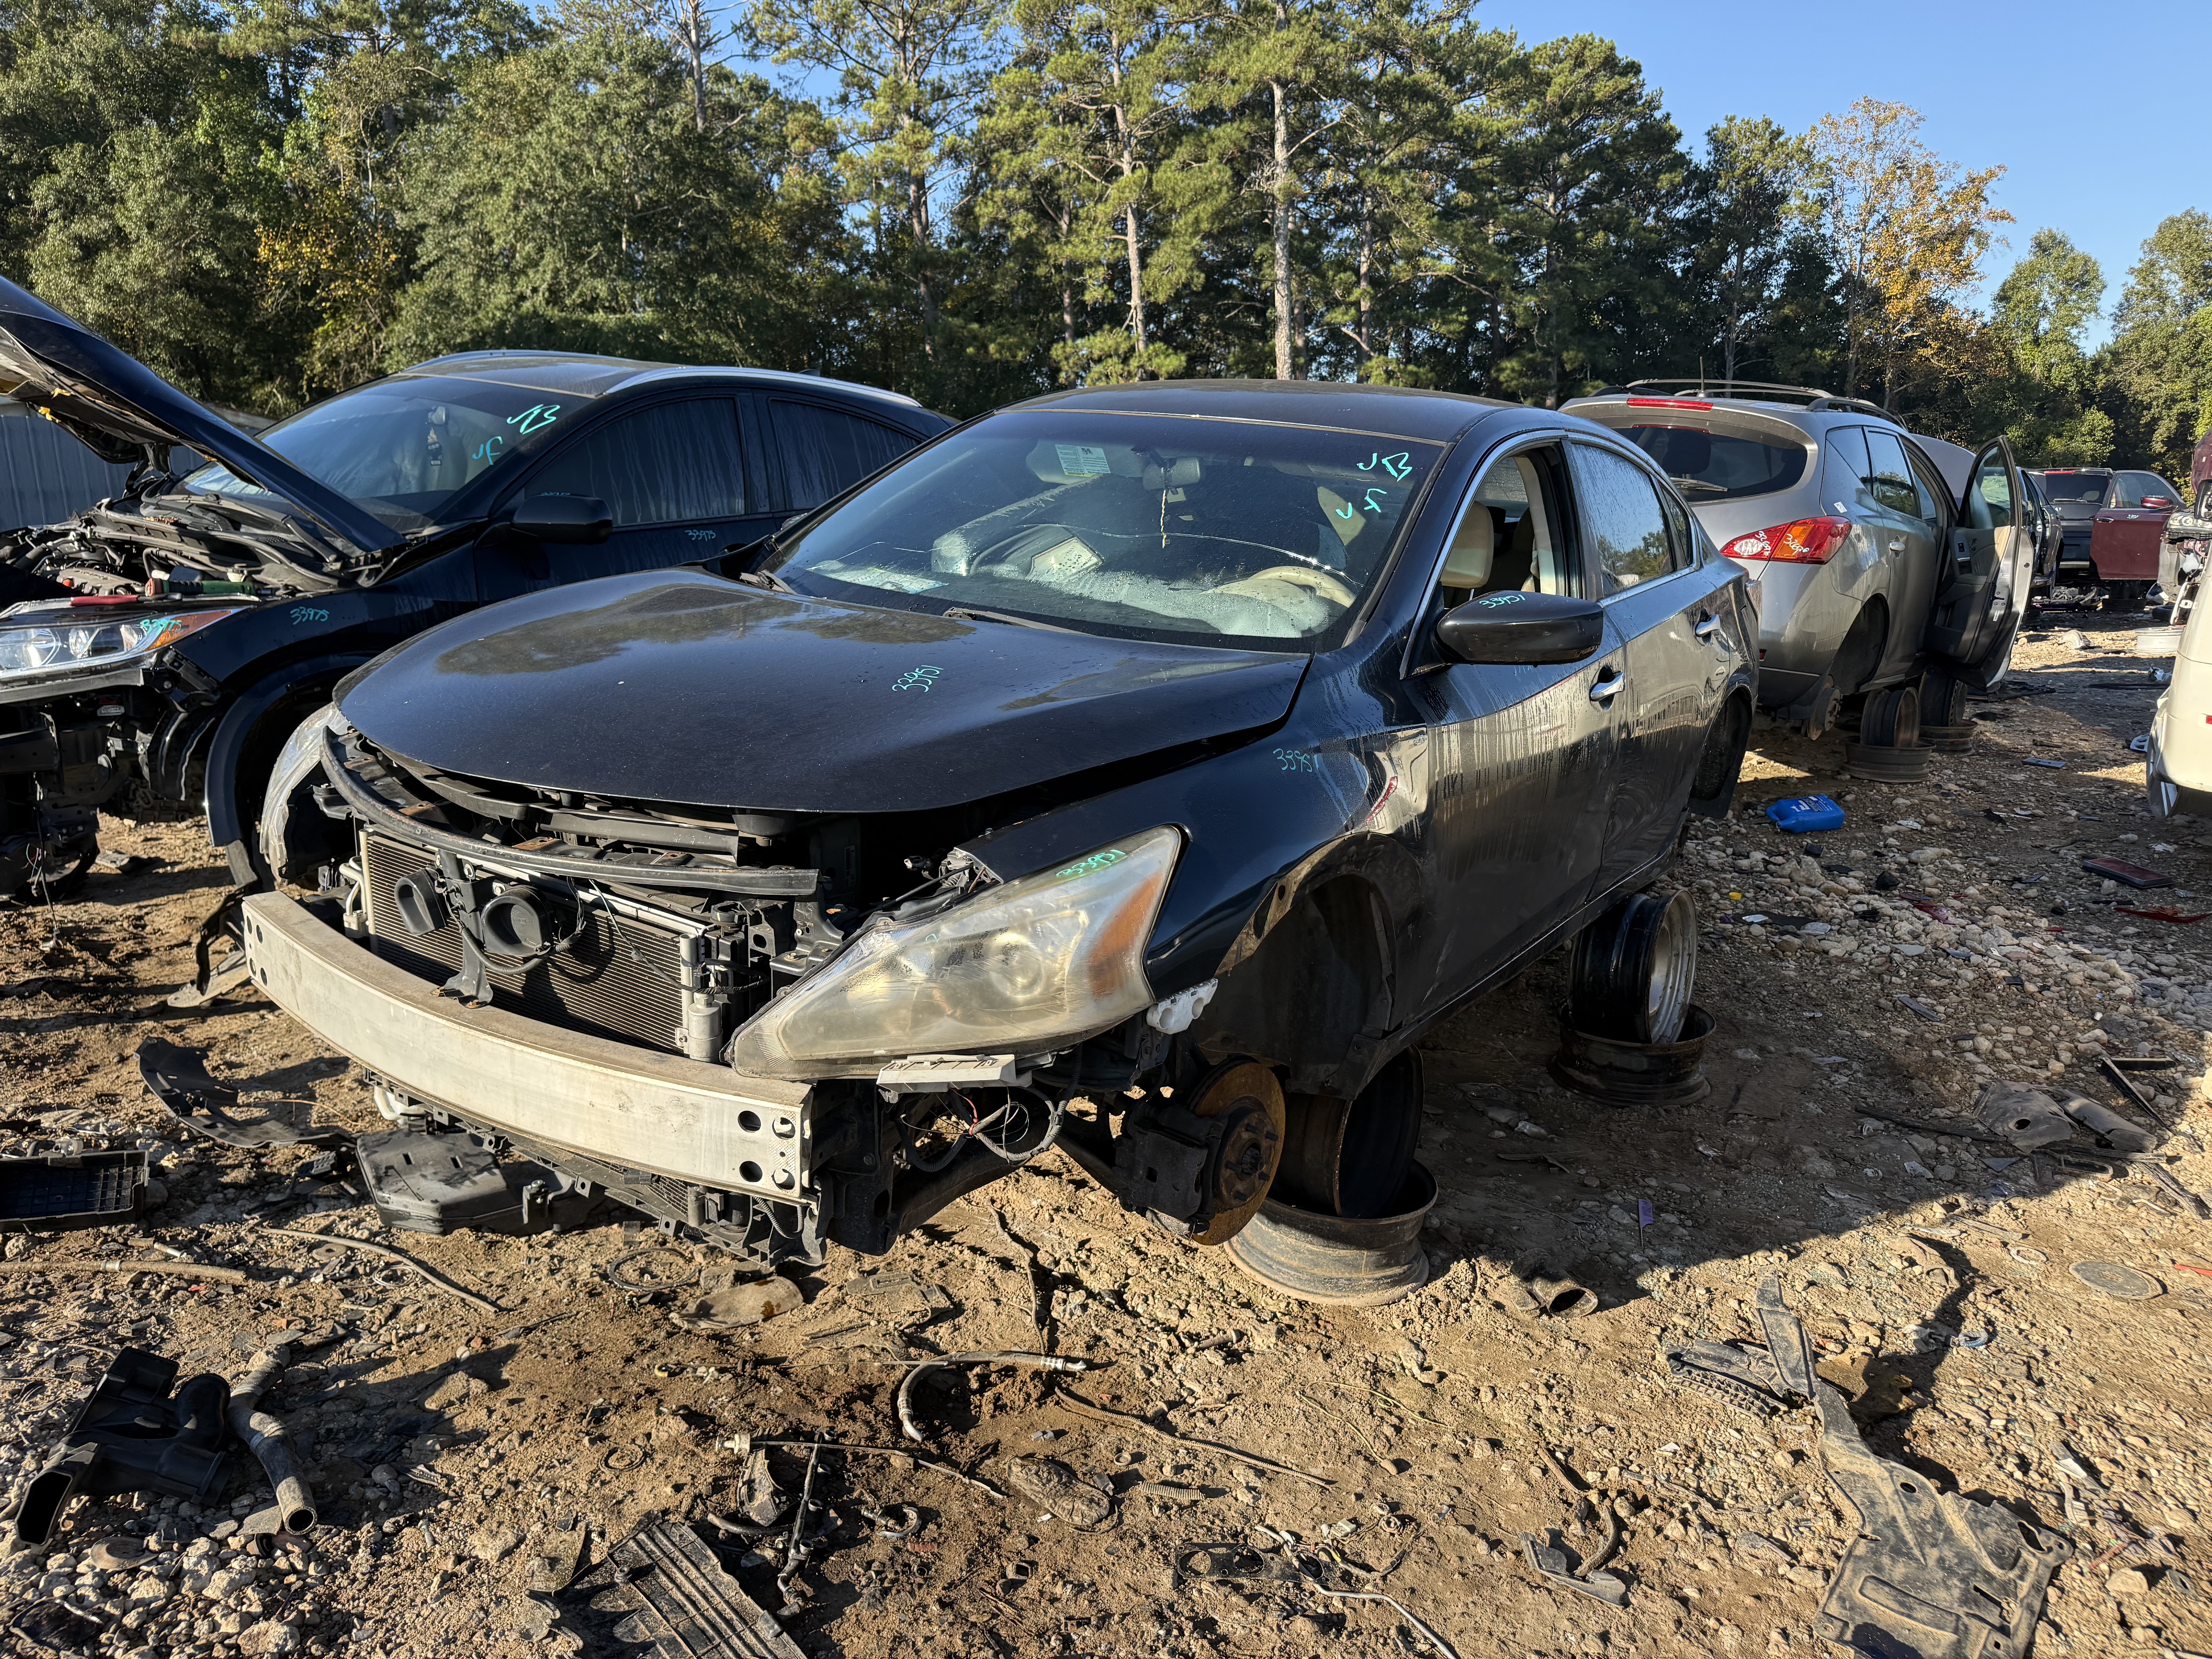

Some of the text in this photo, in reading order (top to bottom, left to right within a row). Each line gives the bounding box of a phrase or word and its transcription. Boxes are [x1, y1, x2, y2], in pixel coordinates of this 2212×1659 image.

[685, 530, 716, 541] 33975
[1479, 594, 1525, 608] 33951
[290, 606, 330, 625] 33975
[892, 665, 944, 692] 33951
